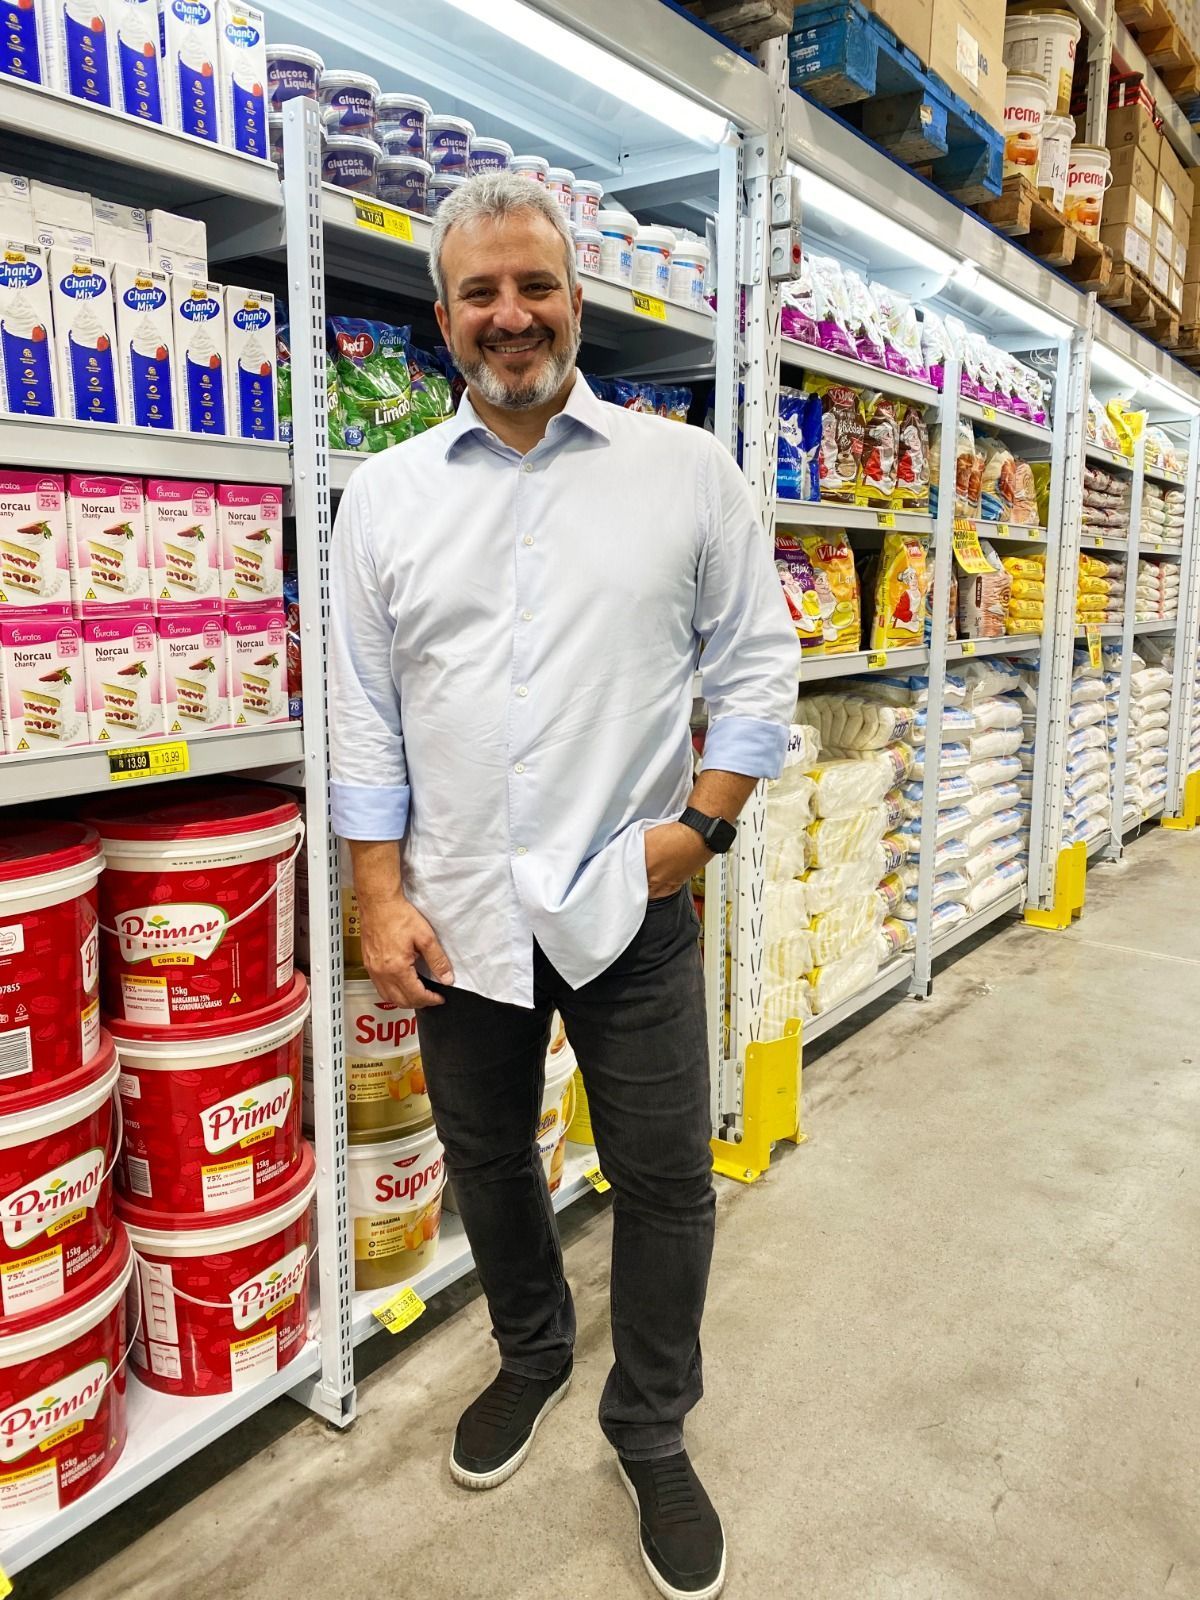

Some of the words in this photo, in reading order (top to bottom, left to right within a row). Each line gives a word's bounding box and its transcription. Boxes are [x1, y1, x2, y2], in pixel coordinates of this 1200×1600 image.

[174, 2, 208, 16] Chanty
[183, 14, 200, 25] Mix
[227, 25, 256, 42] Chanty
[234, 37, 248, 48] Mix
[270, 69, 308, 80] Glucose
[327, 159, 364, 169] Glucose
[0, 264, 38, 280] Chanty
[8, 277, 28, 289] Mix
[64, 277, 103, 292] Chanty
[75, 289, 94, 300] Mix
[127, 290, 163, 304] Chanty
[137, 302, 154, 312] Mix
[183, 300, 217, 314] Chanty
[192, 311, 209, 323] Mix
[236, 309, 268, 323] Chanty
[244, 321, 260, 332] Mix
[343, 337, 364, 354] Apti
[375, 398, 411, 425] Limão
[348, 429, 358, 438] 78
[82, 486, 106, 494] puratos
[158, 491, 180, 499] puratos
[81, 503, 115, 513] Norcau
[158, 507, 188, 516] Norcau
[228, 512, 256, 521] Norcau
[237, 624, 256, 632] puratos
[15, 633, 42, 642] puratos
[169, 643, 199, 652] Norcau
[236, 640, 264, 648] Norcau
[14, 651, 52, 661] Norcau
[95, 647, 129, 656] Norcau
[290, 702, 299, 710] 78
[127, 756, 147, 769] 13,99
[161, 751, 180, 763] 13,99
[121, 915, 220, 951] Primor
[125, 985, 137, 993] 75%
[170, 986, 188, 996] 15kg
[355, 1014, 417, 1047] Supr
[351, 1061, 384, 1069] MARGARINA
[209, 1087, 290, 1140] Primor
[245, 1133, 261, 1145] com
[255, 1159, 270, 1170] 15kg
[206, 1174, 222, 1183] 75%
[9, 1161, 102, 1233] Primor
[54, 1218, 70, 1232] com
[71, 1210, 84, 1224] Sal
[66, 1245, 81, 1259] 15kg
[6, 1270, 26, 1282] 75%
[234, 1348, 249, 1358] 75%
[1, 1371, 104, 1448] Primor
[46, 1432, 64, 1447] com
[64, 1423, 81, 1437] Sal
[60, 1457, 78, 1472] 15kg
[1, 1483, 18, 1493] 75%
